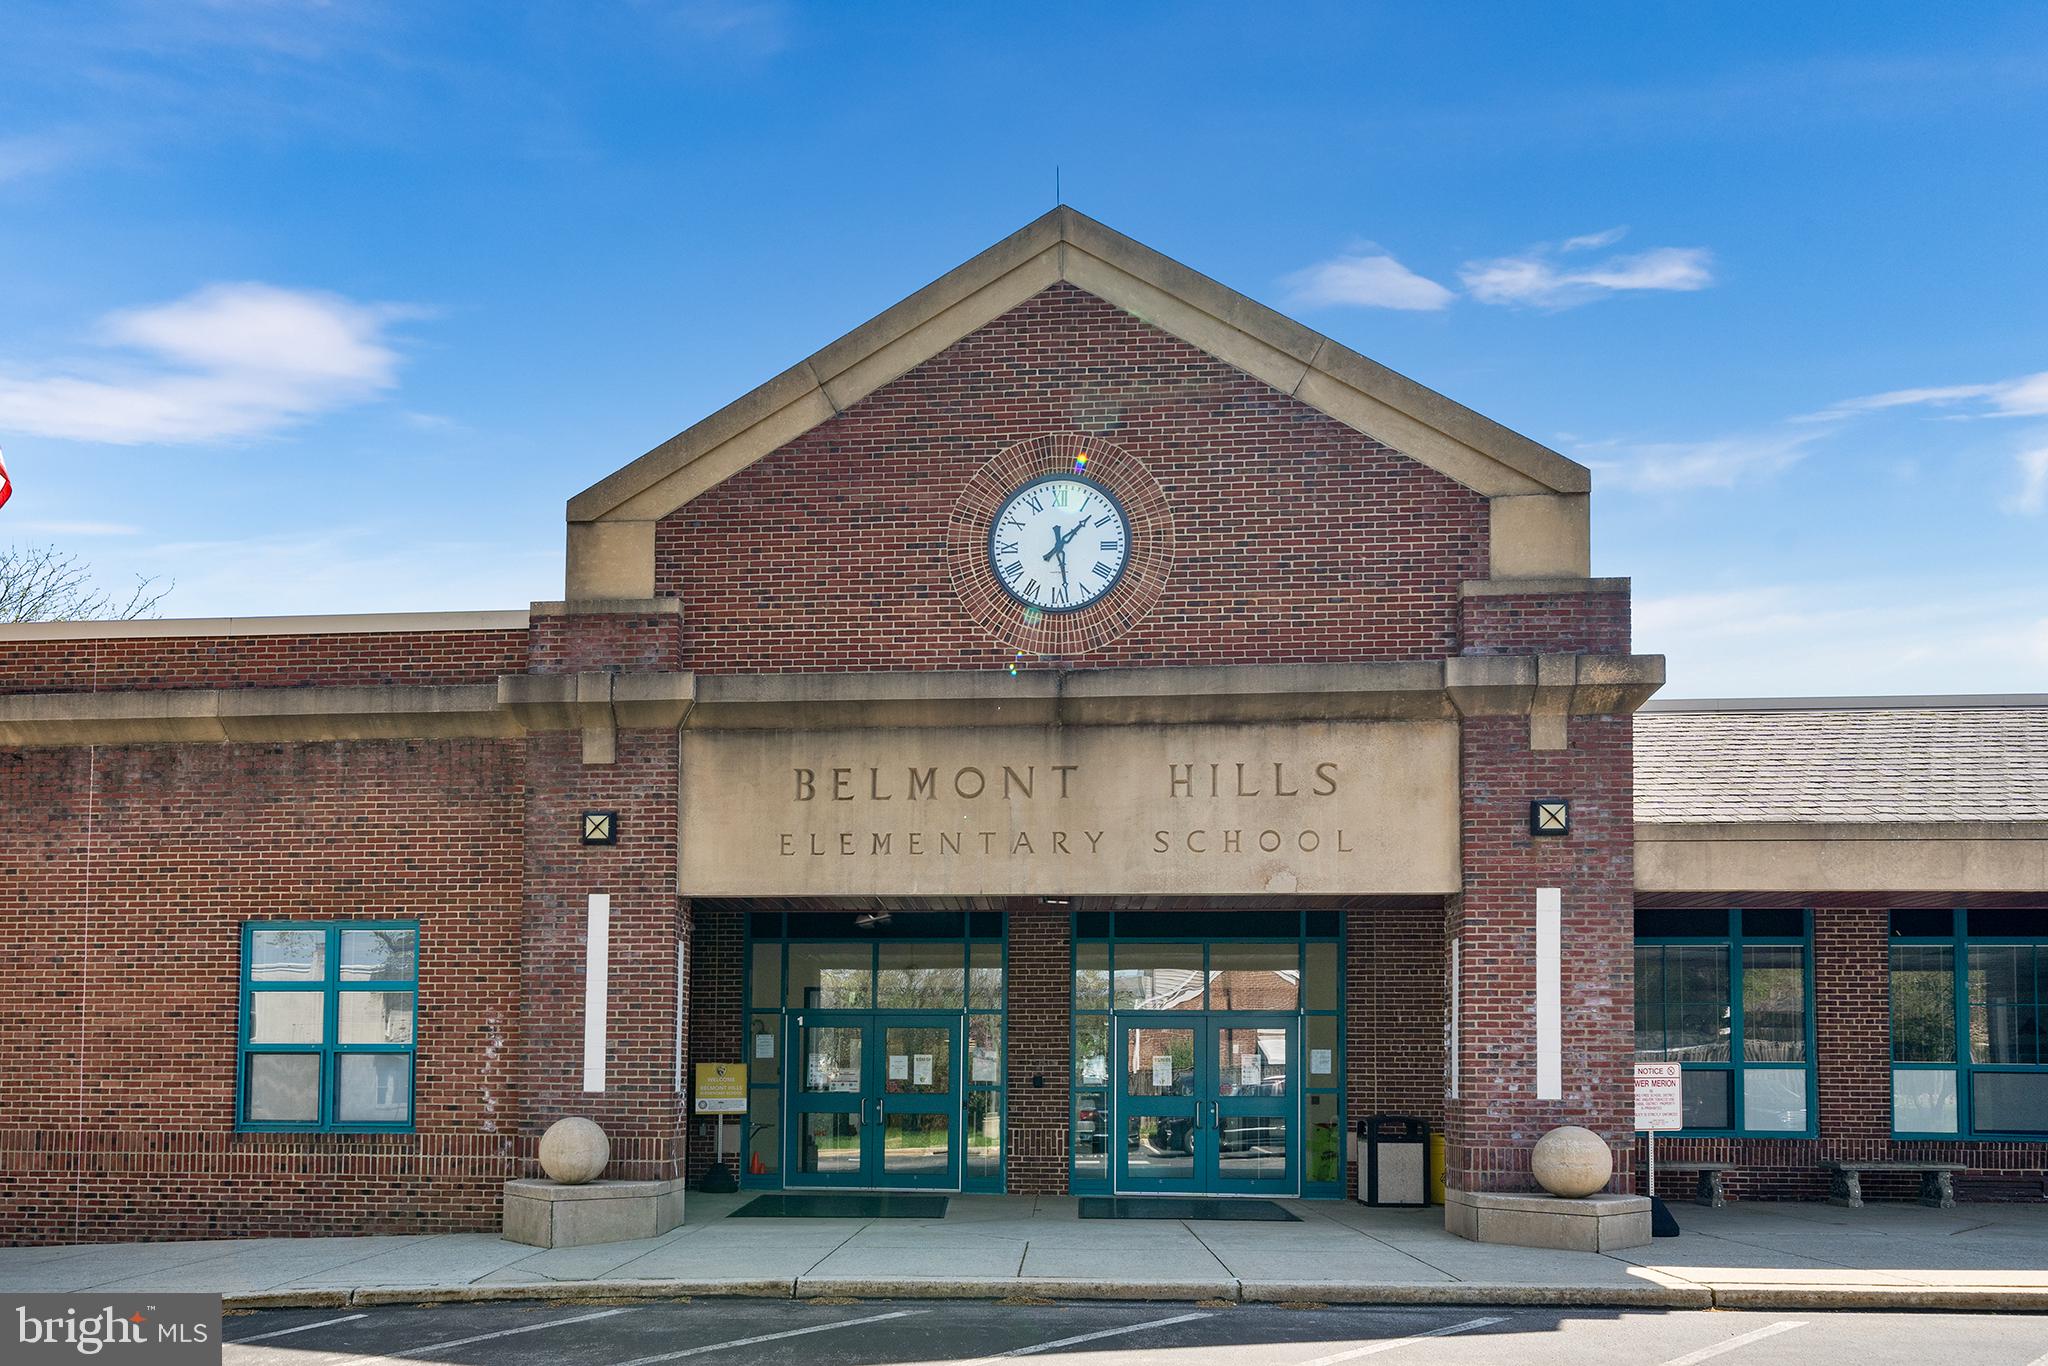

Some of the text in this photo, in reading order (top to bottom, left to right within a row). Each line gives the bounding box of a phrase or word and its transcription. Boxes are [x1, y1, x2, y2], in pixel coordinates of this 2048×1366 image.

[1052, 489, 1068, 507] XII
[1026, 495, 1044, 516] XI
[1007, 516, 1026, 531] X
[1094, 515, 1112, 529] II
[1000, 541, 1018, 554] IX
[1100, 540, 1118, 551] III
[793, 762, 1338, 802] BELMONT HILLS
[779, 829, 1353, 856] ELEMENTARY SCHOOL
[797, 1016, 804, 1026] 1
[1637, 1067, 1664, 1075] NOTICE
